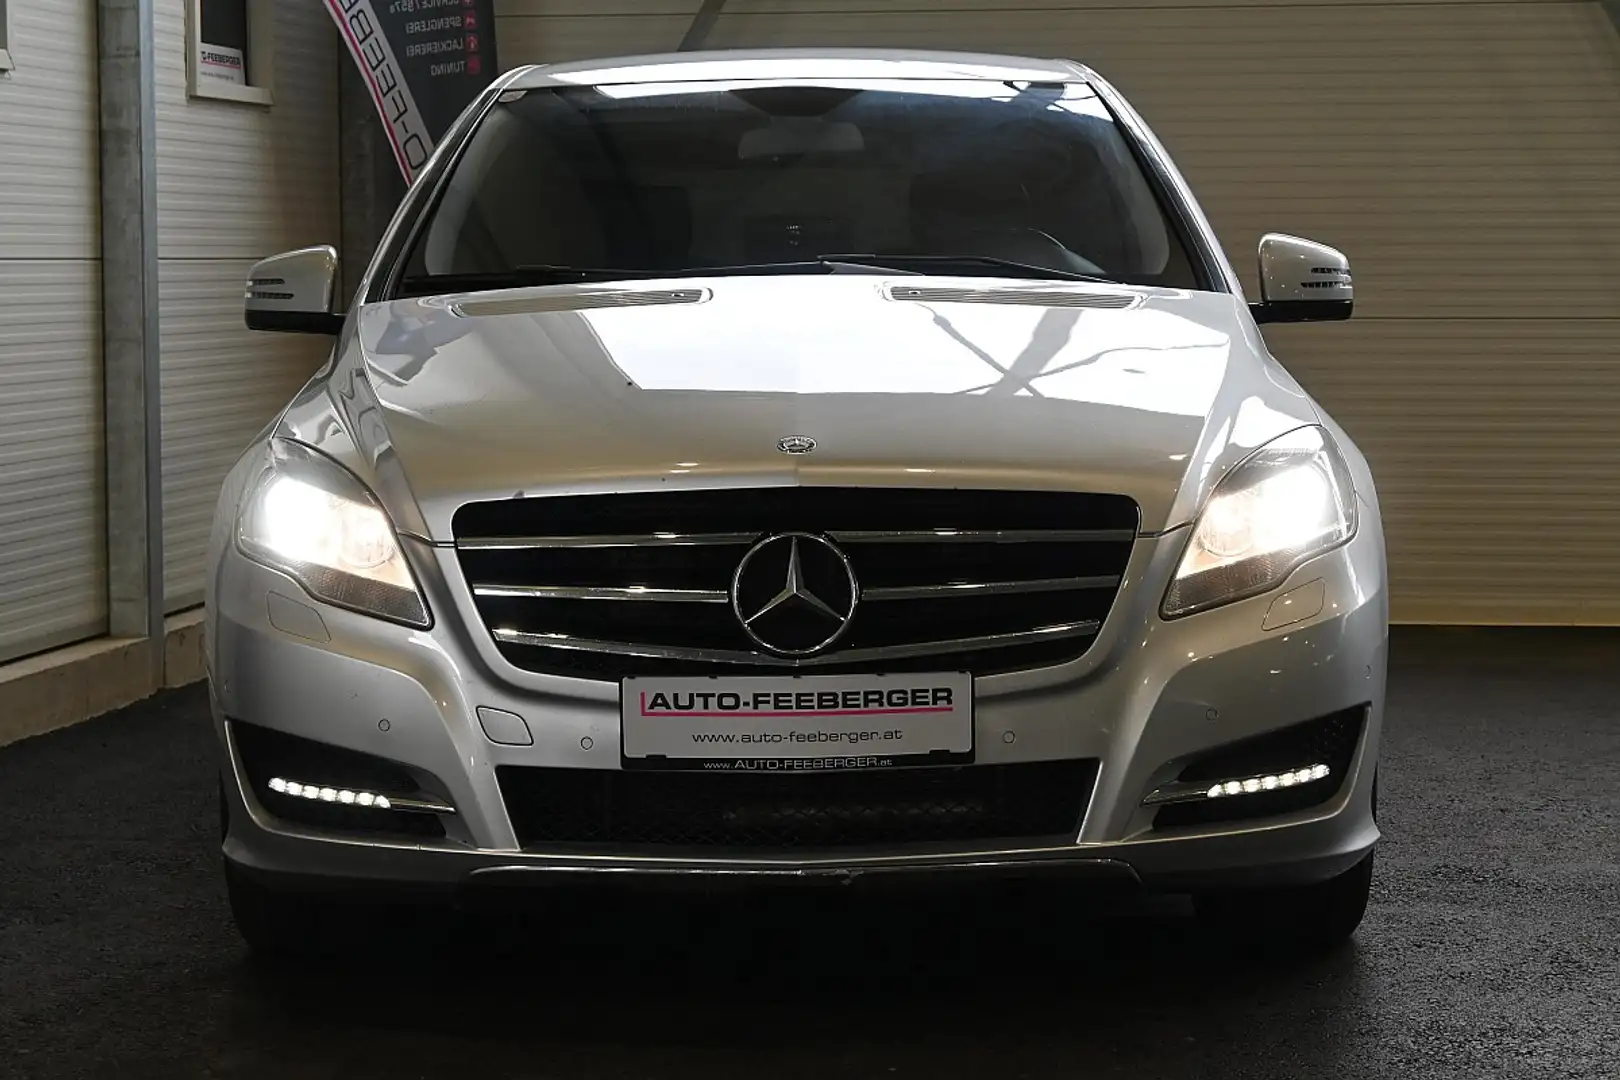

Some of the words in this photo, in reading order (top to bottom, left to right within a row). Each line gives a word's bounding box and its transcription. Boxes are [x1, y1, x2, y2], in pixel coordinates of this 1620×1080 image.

[647, 687, 953, 711] AUTO-FEEBERGER
[692, 728, 903, 744] www.auto-feeberger.at
[703, 757, 893, 770] www.AUTO-FEEBERGER.at
